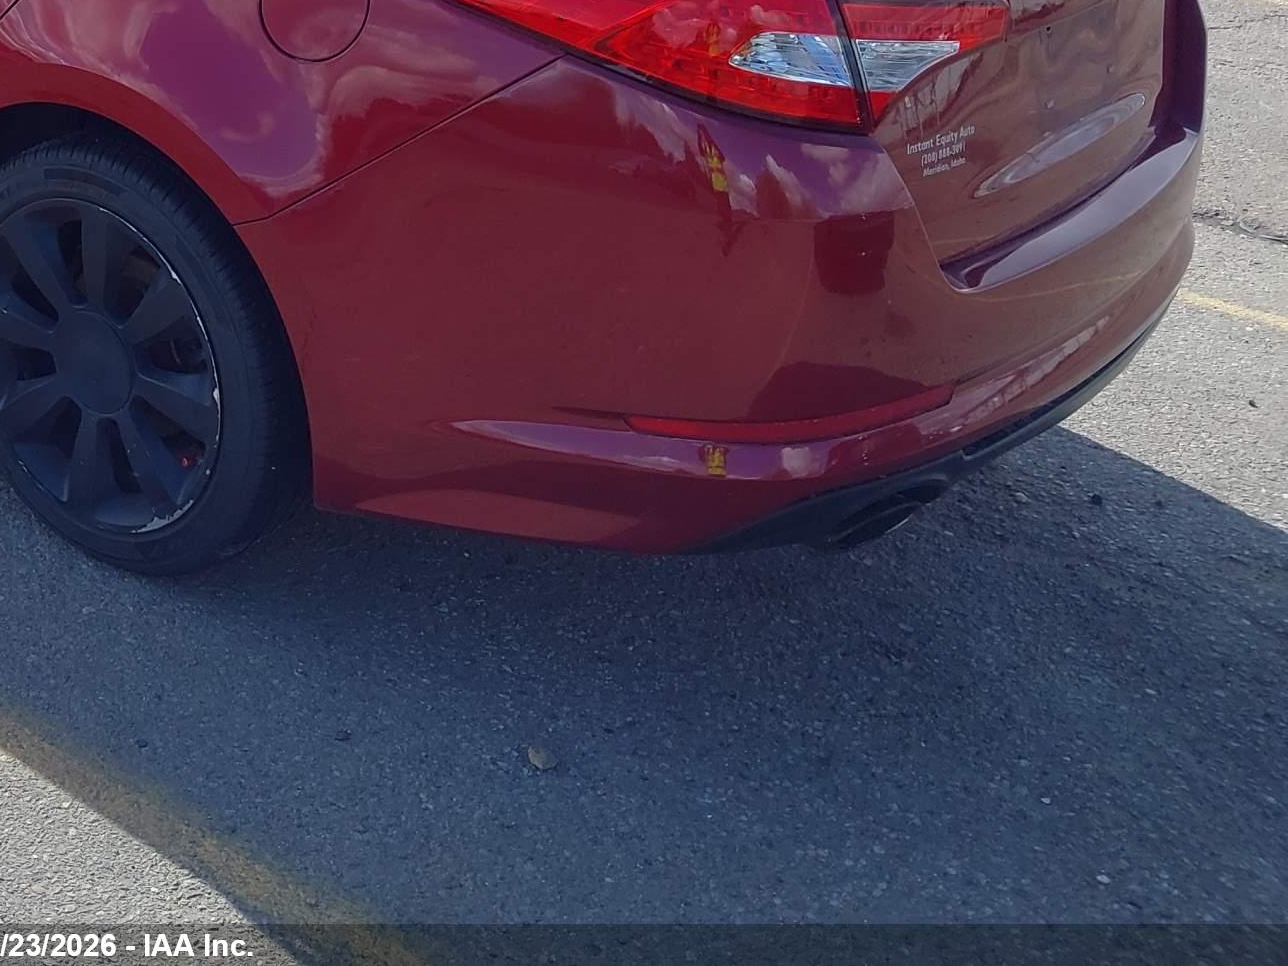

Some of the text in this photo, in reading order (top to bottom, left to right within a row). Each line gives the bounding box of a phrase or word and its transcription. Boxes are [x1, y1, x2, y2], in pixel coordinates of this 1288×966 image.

[906, 125, 975, 154] Instant Equity Auto
[950, 156, 966, 167] Idaho
